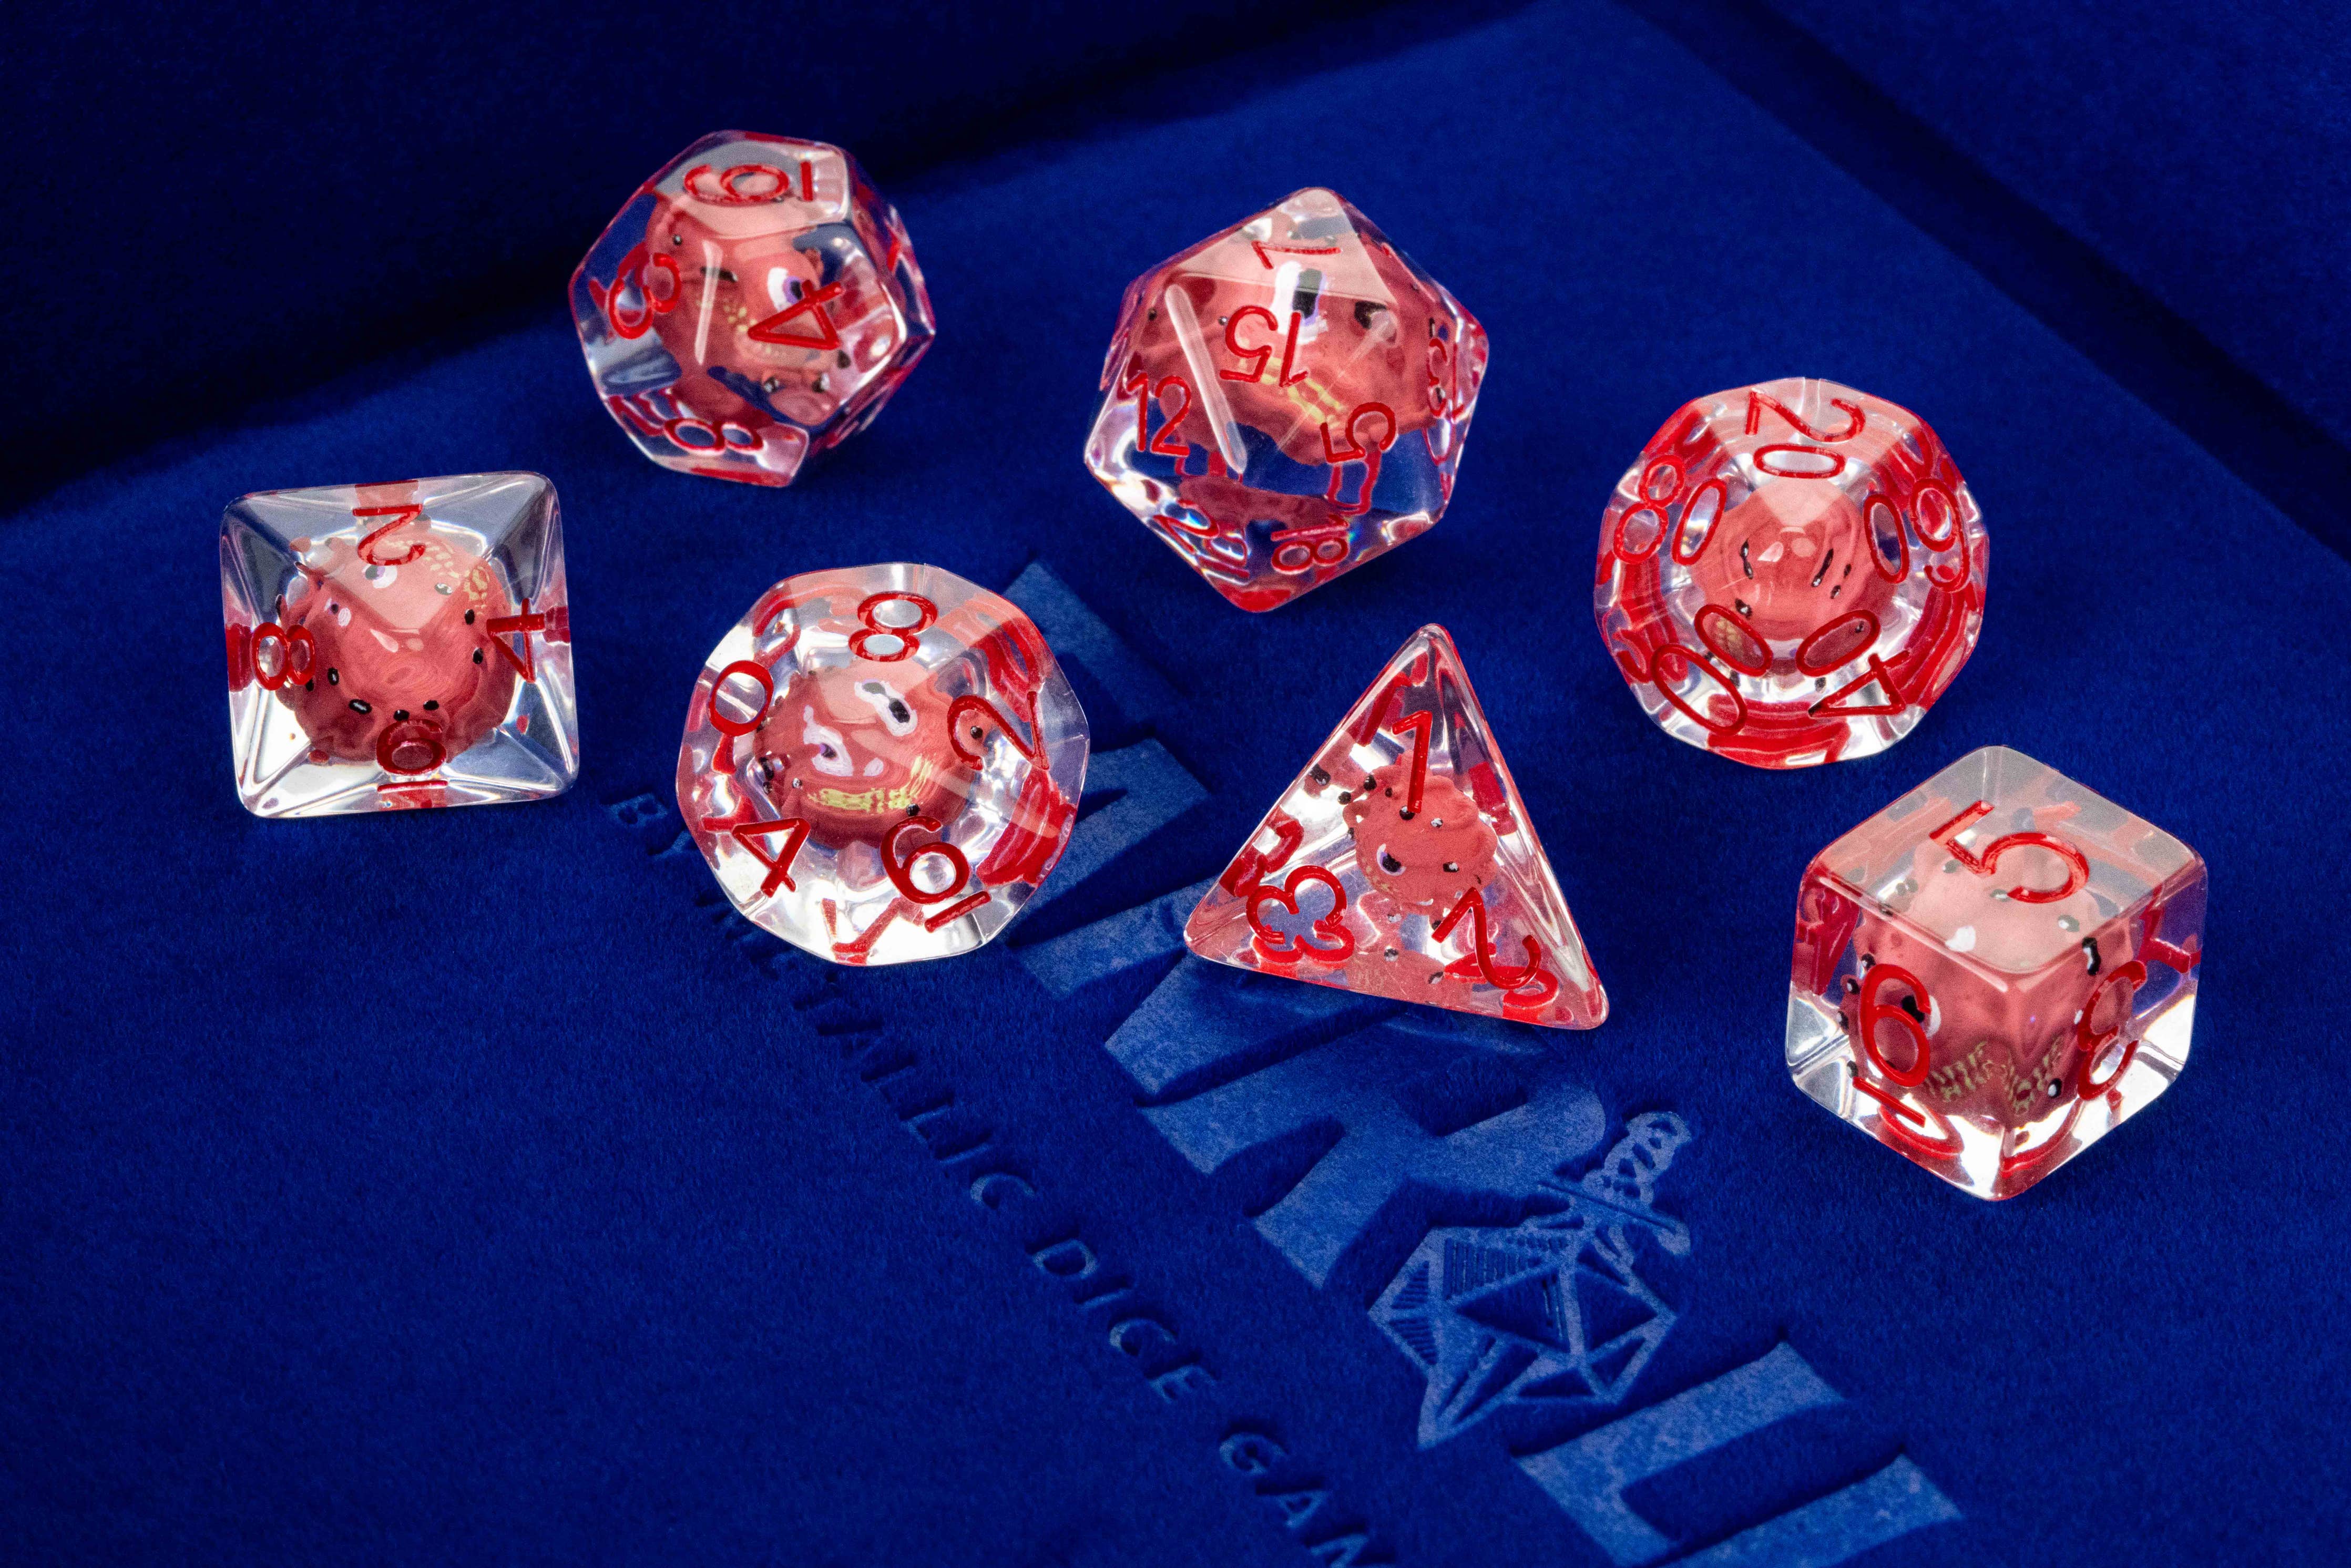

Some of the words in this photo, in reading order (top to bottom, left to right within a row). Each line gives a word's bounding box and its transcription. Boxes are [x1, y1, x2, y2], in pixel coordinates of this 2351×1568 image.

[747, 280, 843, 351] 4
[1219, 305, 1309, 387] 15
[1127, 372, 1191, 457] 12
[1320, 402, 1397, 464] 5
[352, 503, 424, 566] 2
[250, 621, 315, 691] 8
[486, 598, 546, 683] 4
[848, 590, 938, 662] 8
[708, 660, 774, 736] 0
[947, 691, 1050, 771] 2
[1392, 710, 1434, 814] 1
[732, 817, 811, 898] 4
[1929, 800, 2090, 904] 5
[1245, 864, 1348, 947] 3
[1431, 887, 1542, 990] 2
[1028, 1233, 1219, 1403] DICE
